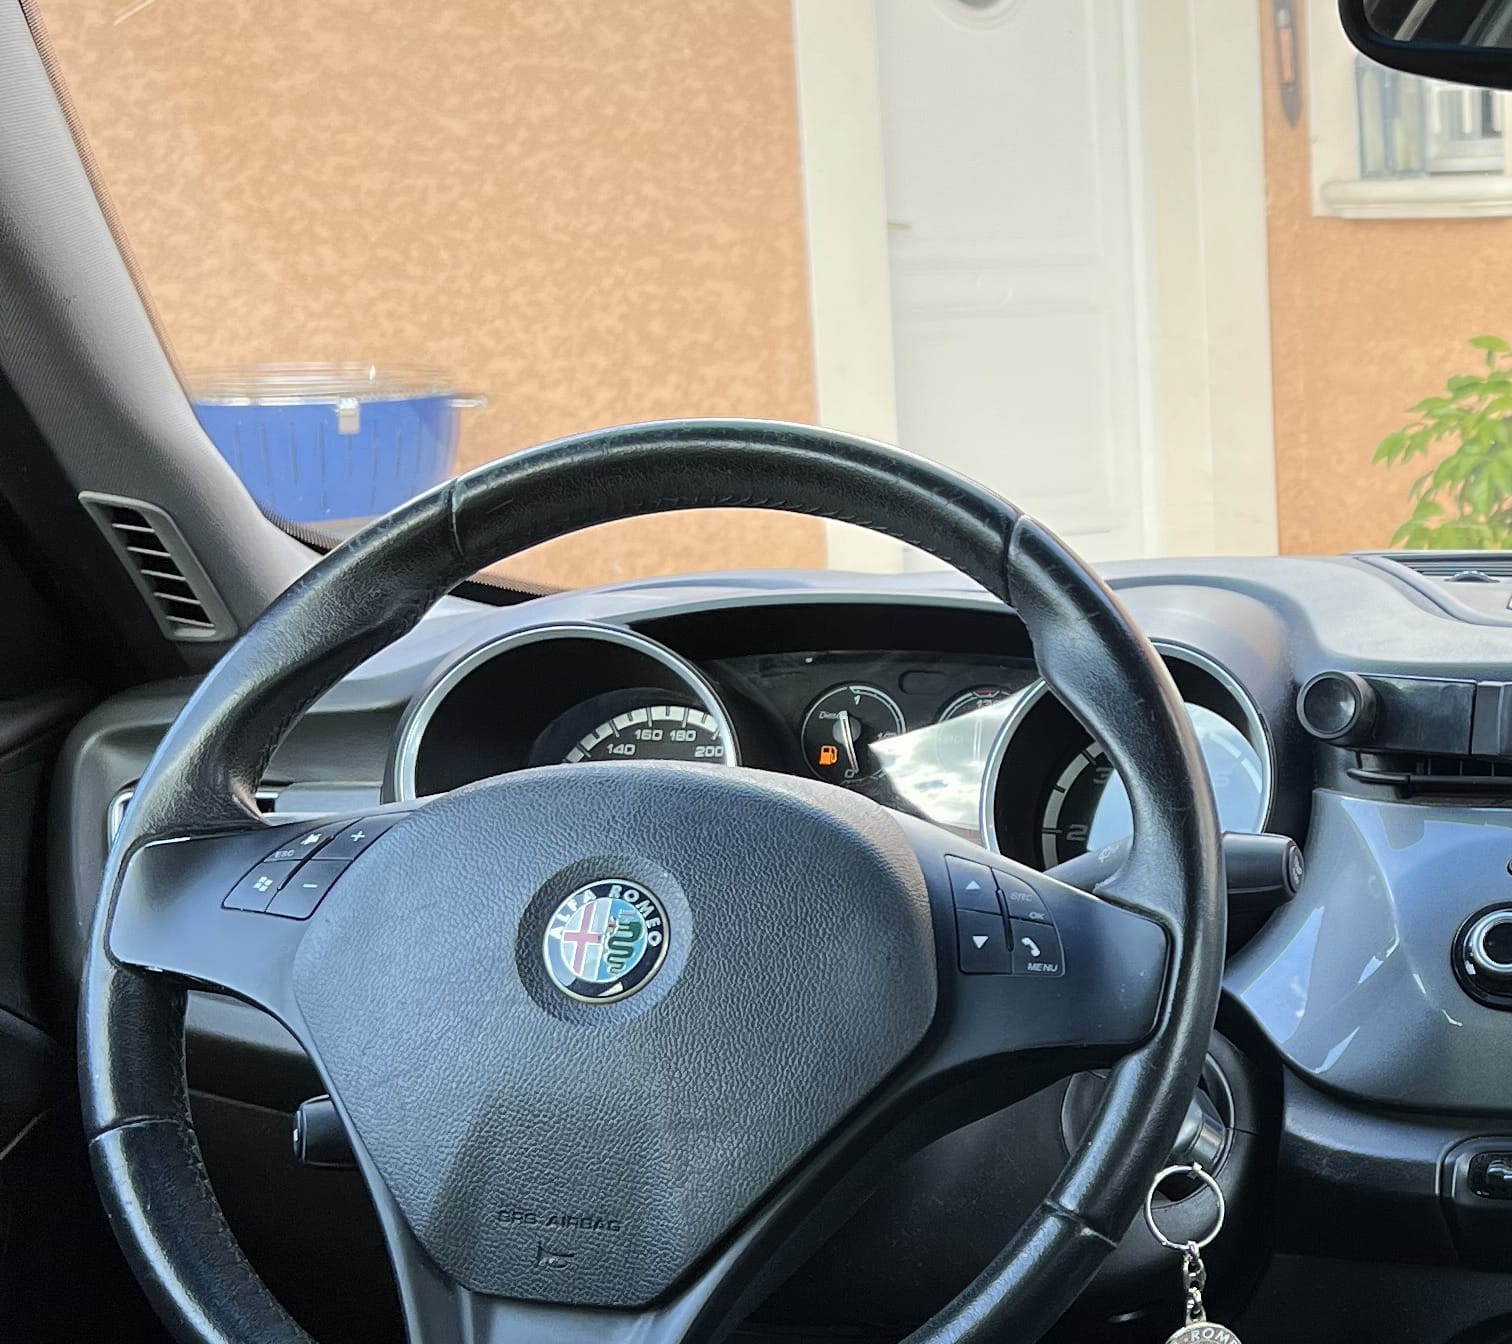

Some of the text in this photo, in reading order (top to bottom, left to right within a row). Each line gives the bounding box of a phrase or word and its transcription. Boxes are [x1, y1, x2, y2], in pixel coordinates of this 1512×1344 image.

[634, 729, 663, 741] 160
[669, 729, 697, 742] 180
[607, 743, 636, 756] 140
[694, 746, 724, 758] 200
[1066, 824, 1089, 841] 2
[549, 884, 663, 947] ALFA ROMEO
[1028, 911, 1045, 920] OK
[1027, 962, 1058, 973] MENU
[546, 1214, 621, 1232] AIRBAG
